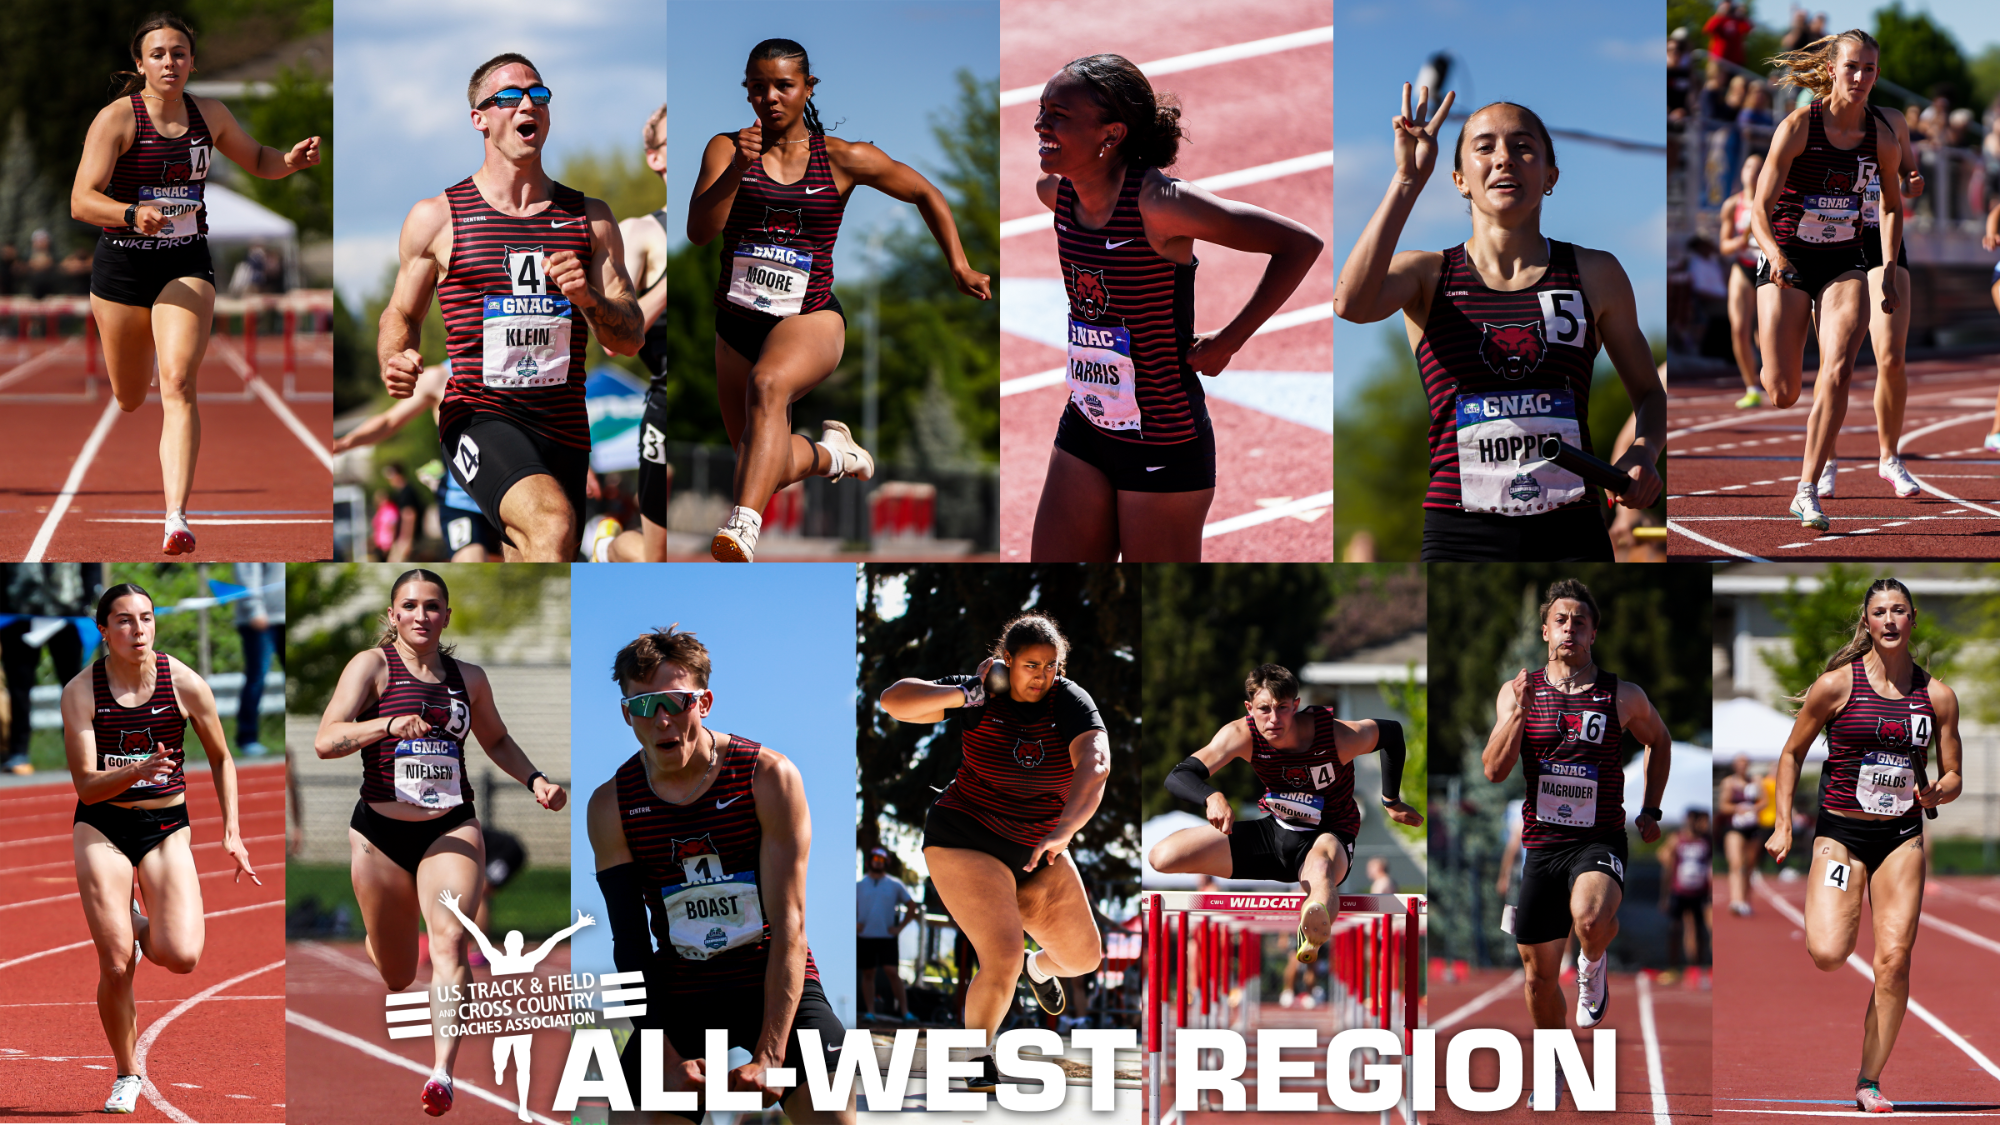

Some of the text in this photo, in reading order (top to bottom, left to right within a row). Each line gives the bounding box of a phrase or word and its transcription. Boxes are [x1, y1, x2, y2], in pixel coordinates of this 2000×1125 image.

[195, 148, 208, 178] 4
[1859, 164, 1874, 191] 5
[153, 185, 188, 198] GNAC
[160, 204, 197, 216] GROOT
[1818, 197, 1850, 209] GNAC
[517, 255, 540, 294] 4
[746, 266, 794, 292] MOORE
[502, 298, 554, 314] GNAC
[1551, 294, 1579, 343] 5
[506, 328, 550, 346] KLEIN
[1483, 393, 1552, 418] GNAC
[460, 442, 479, 475] 4
[1479, 433, 1562, 463] HOPPE
[450, 702, 467, 735] 3
[1586, 713, 1601, 741] 6
[1915, 717, 1928, 745] 4
[412, 741, 449, 754] GNAC
[1551, 763, 1587, 777] GNAC
[1876, 752, 1910, 767] GNAC
[406, 764, 453, 780] NIELSEN
[1317, 766, 1332, 785] 4
[1872, 772, 1907, 789] FIELDS
[1541, 781, 1593, 800] MAGRUDER
[629, 806, 651, 816] CENTRAL
[694, 857, 712, 880] 1
[1830, 864, 1844, 887] 4
[685, 895, 738, 920] BOAST
[1230, 897, 1300, 909] WILDCAT
